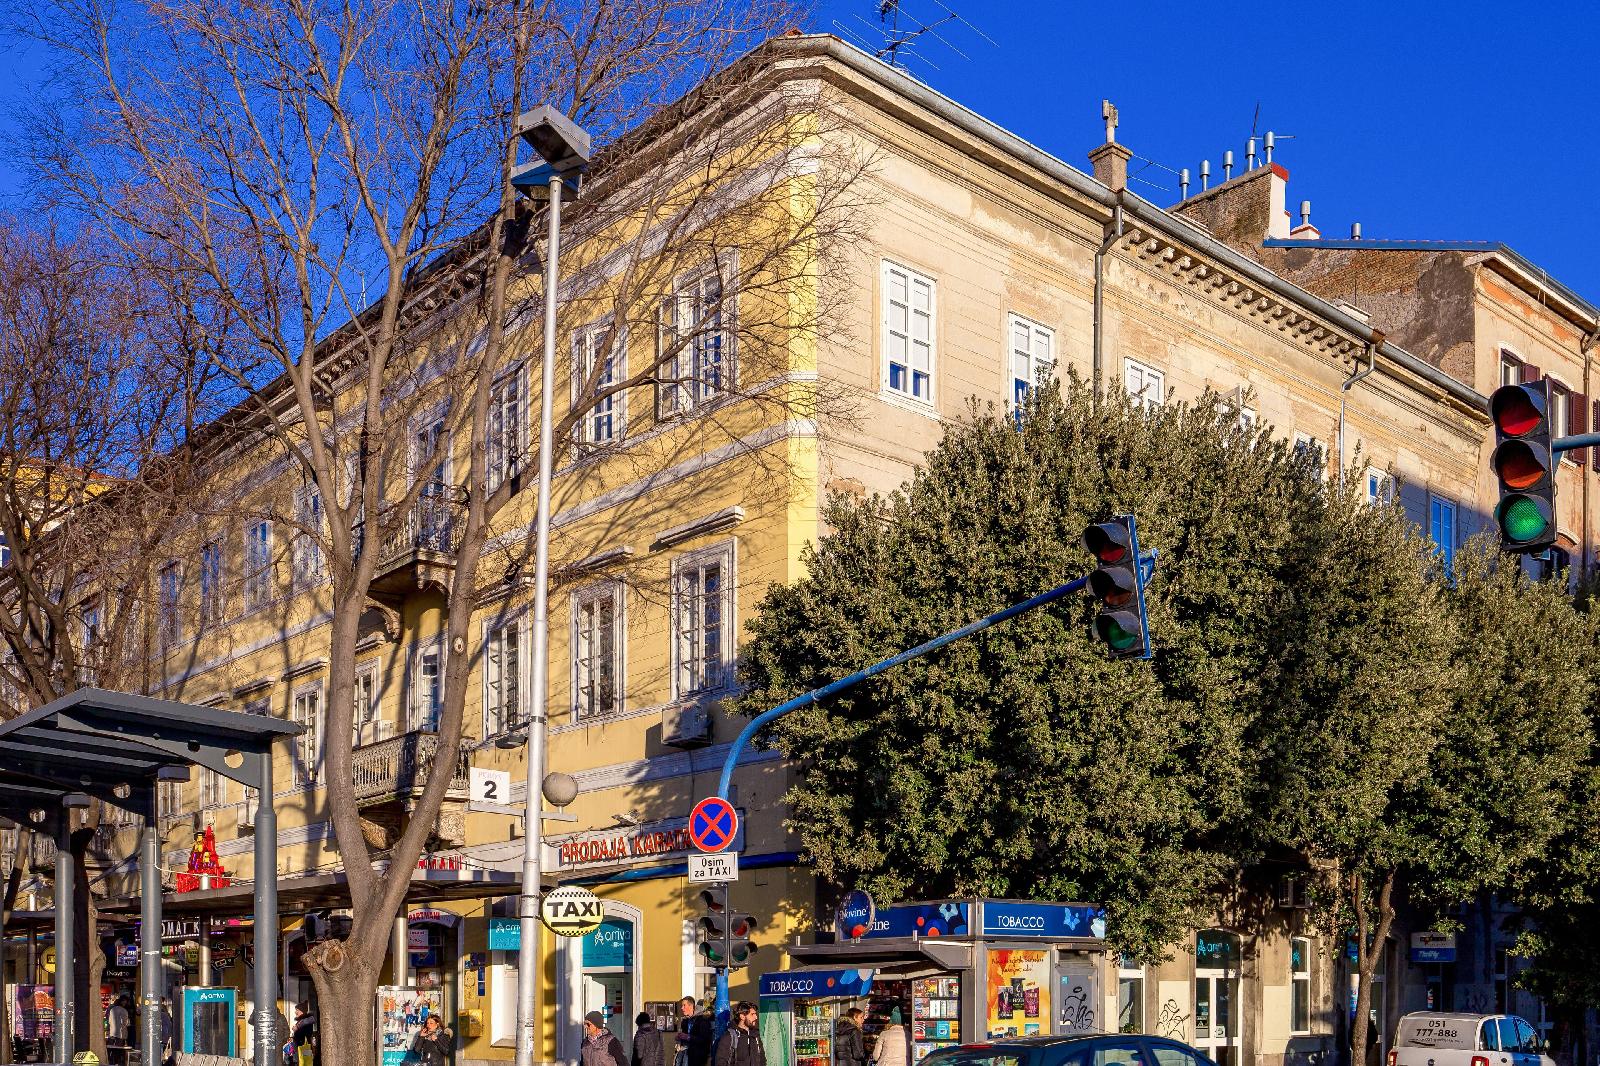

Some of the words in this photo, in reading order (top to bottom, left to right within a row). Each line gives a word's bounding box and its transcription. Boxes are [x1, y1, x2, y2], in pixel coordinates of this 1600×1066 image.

[483, 780, 498, 800] 2
[561, 836, 627, 863] PRODAJA
[701, 858, 724, 867] Osim
[694, 870, 705, 878] za
[709, 867, 731, 876] TAXI
[547, 901, 601, 918] TAXI
[997, 915, 1045, 928] TOBACCO
[769, 979, 814, 993] TOBACCO
[1428, 1020, 1446, 1028] 051
[1415, 1028, 1458, 1038] 777-888
